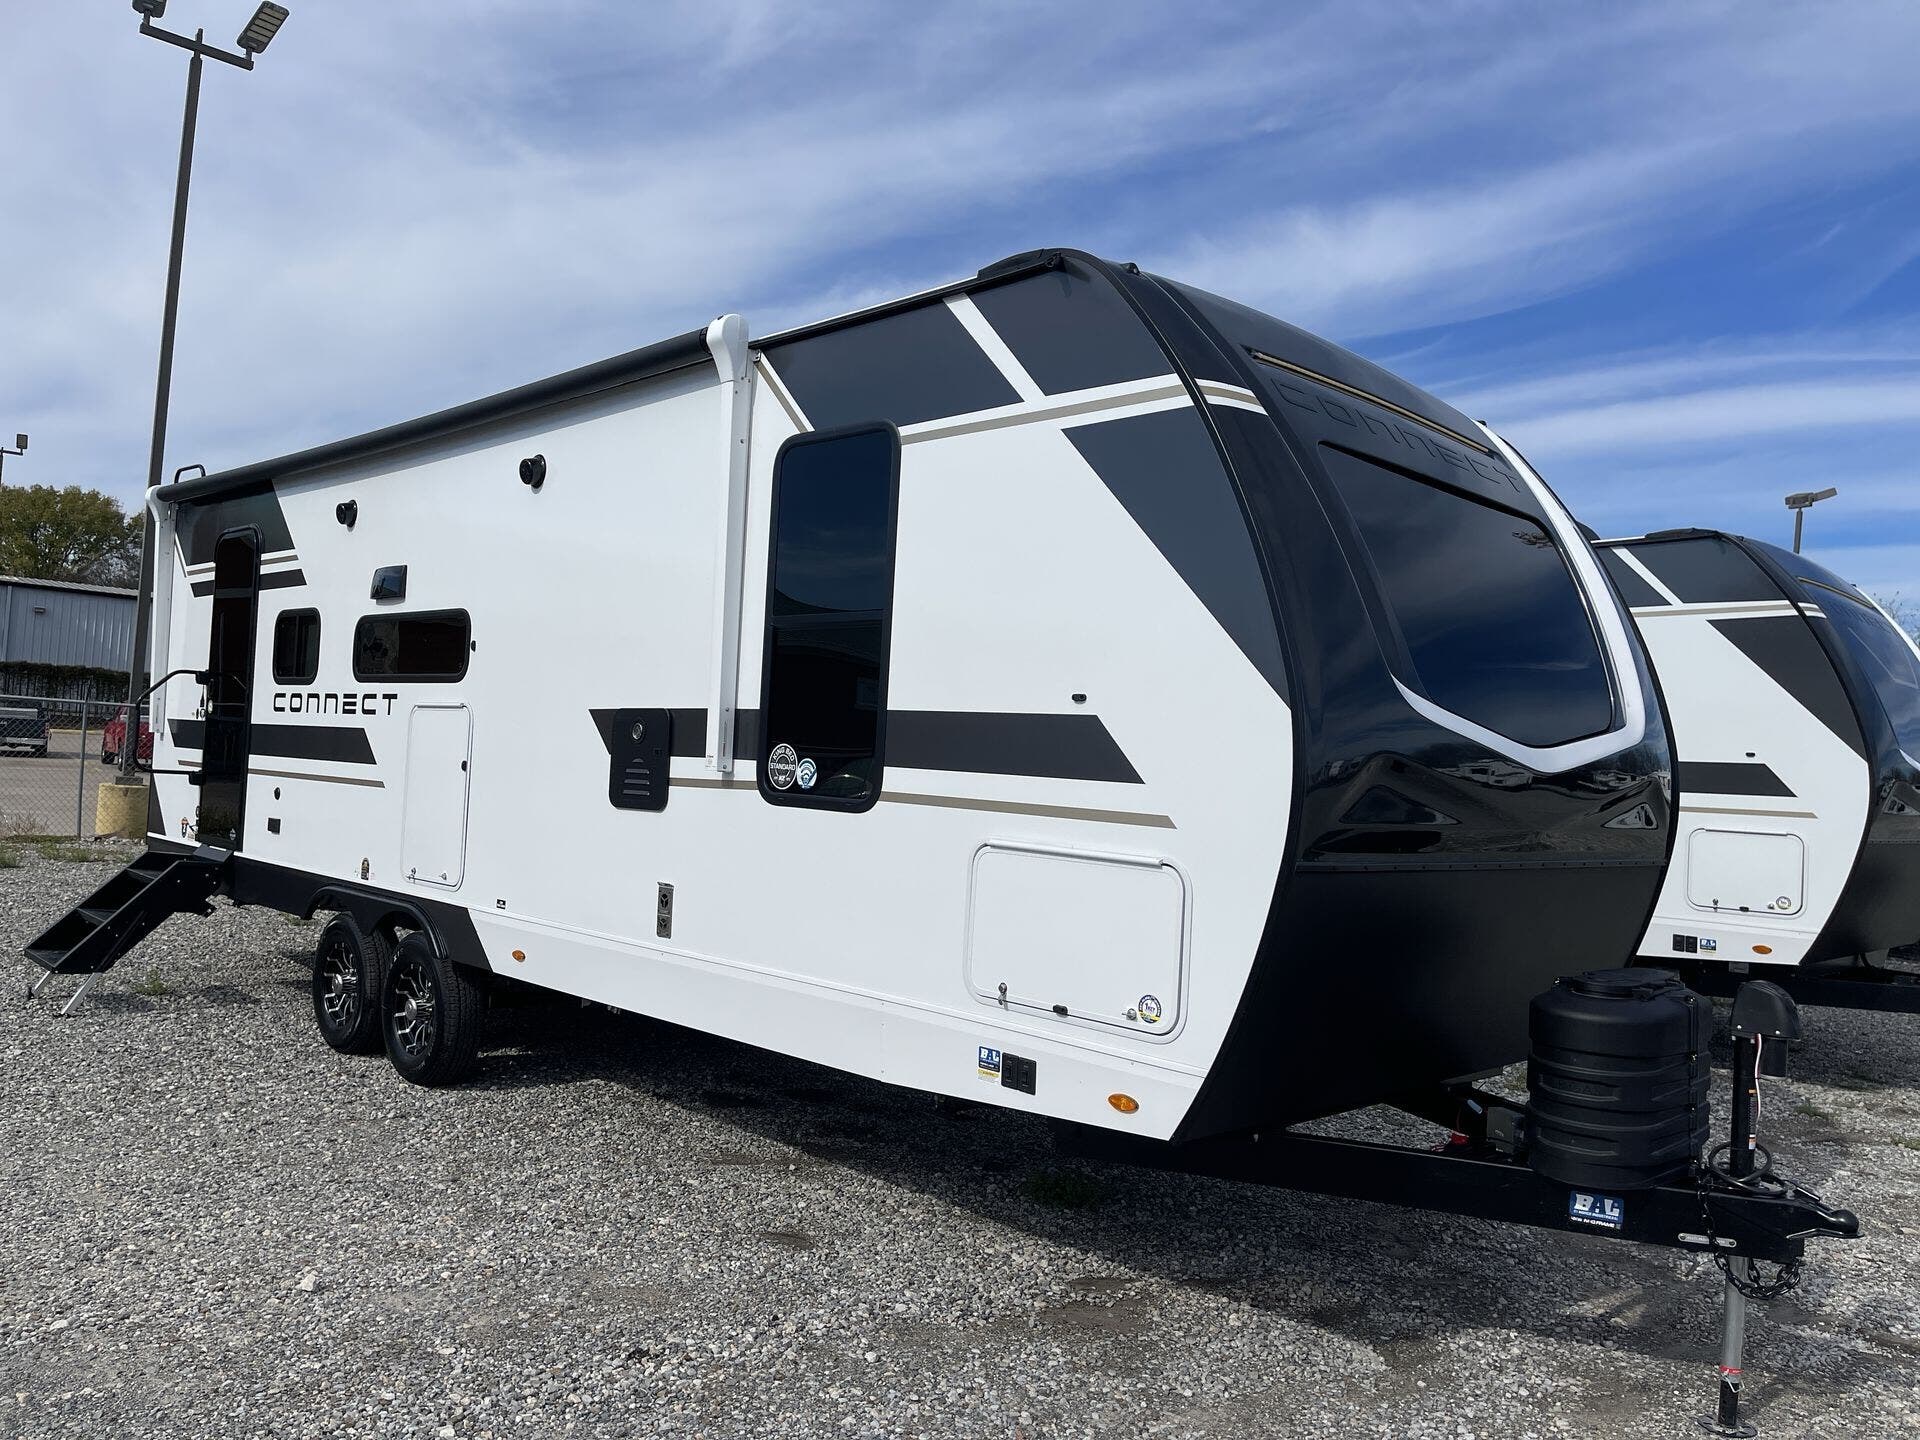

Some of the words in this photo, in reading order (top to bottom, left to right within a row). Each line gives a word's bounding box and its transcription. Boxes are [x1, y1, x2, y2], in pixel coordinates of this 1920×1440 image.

[1270, 378, 1520, 493] CONNECT
[273, 693, 398, 715] CONNECT
[772, 746, 785, 760] KING
[785, 747, 795, 762] BED
[770, 762, 796, 771] STANDARD
